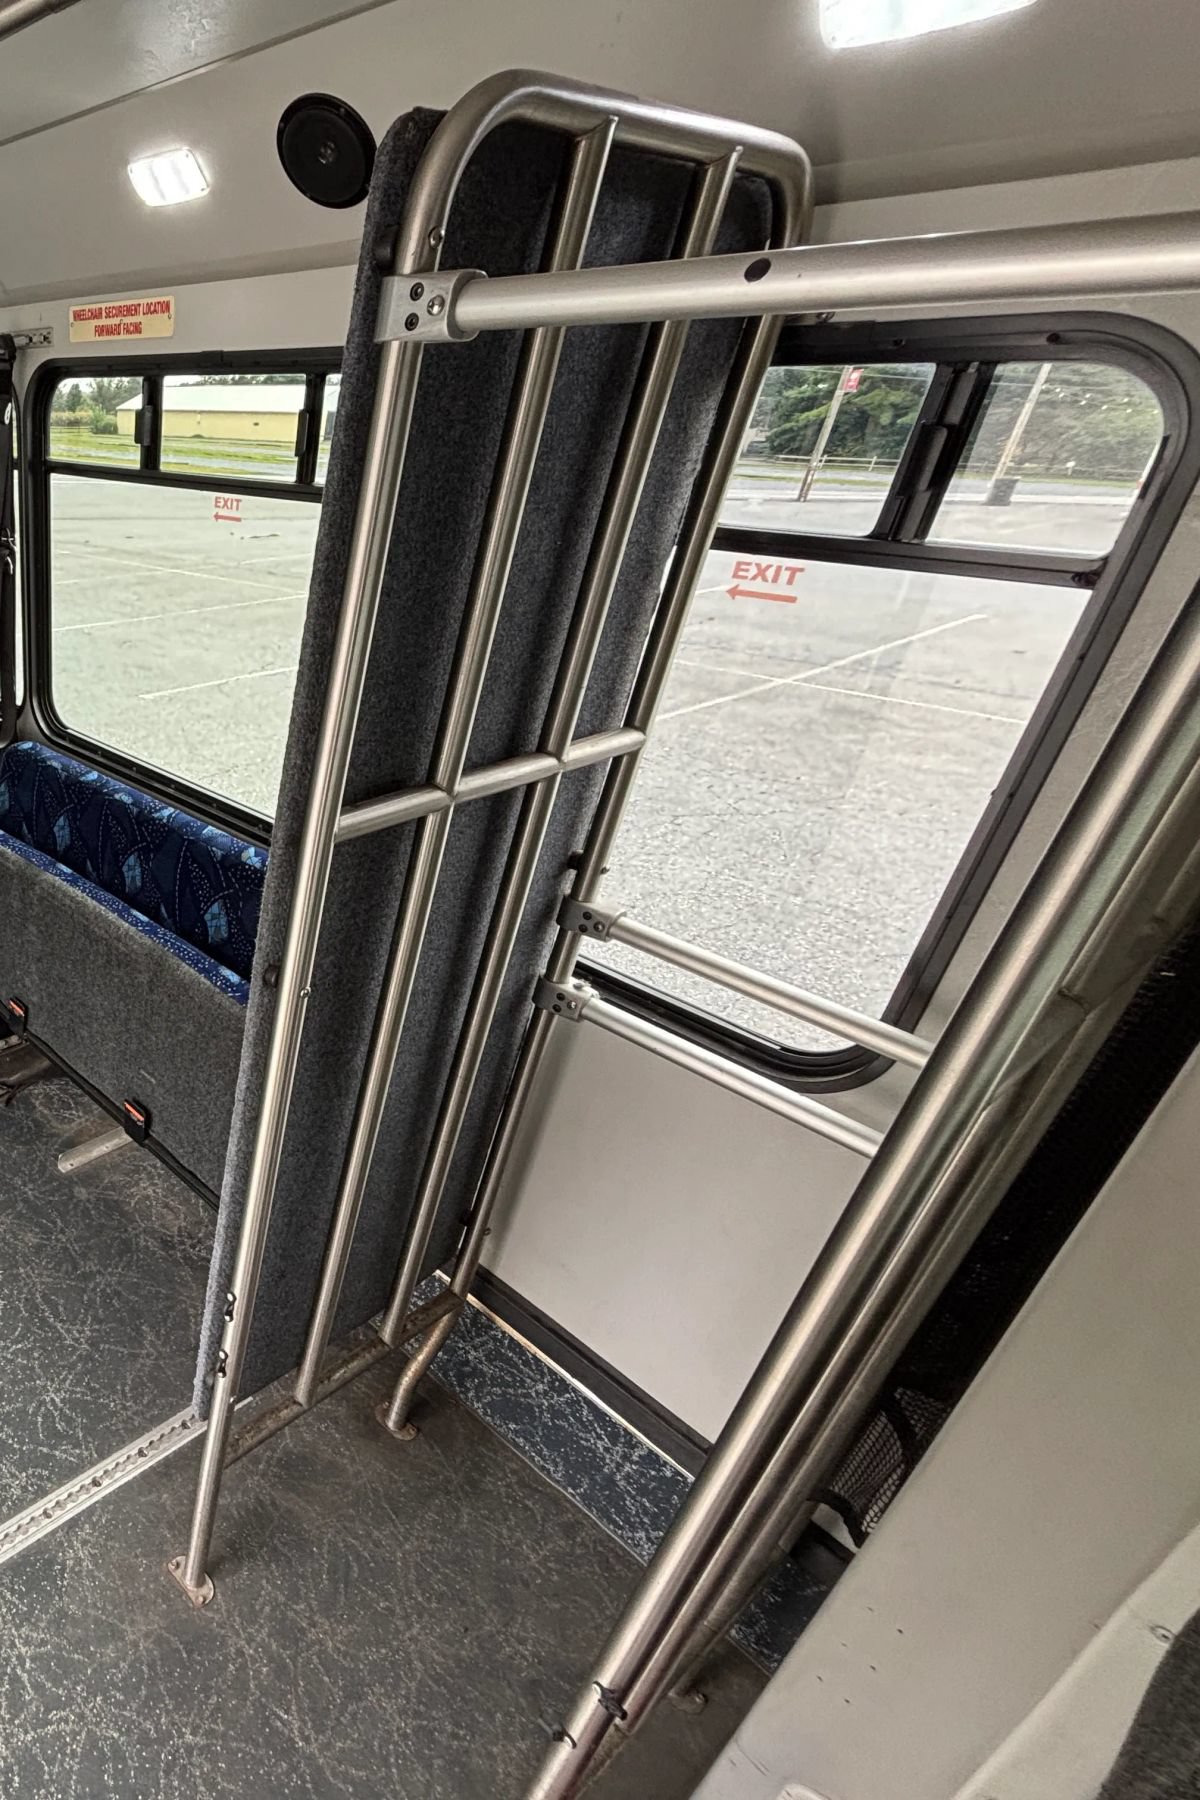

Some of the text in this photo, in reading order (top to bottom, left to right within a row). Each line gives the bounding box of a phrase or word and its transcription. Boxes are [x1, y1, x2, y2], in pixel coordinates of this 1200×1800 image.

[104, 303, 141, 319] SECUREMENT
[142, 300, 171, 316] LOCATION
[94, 321, 142, 337] FORWARD FACING
[214, 496, 242, 511] EXIT
[731, 561, 805, 586] EXIT
